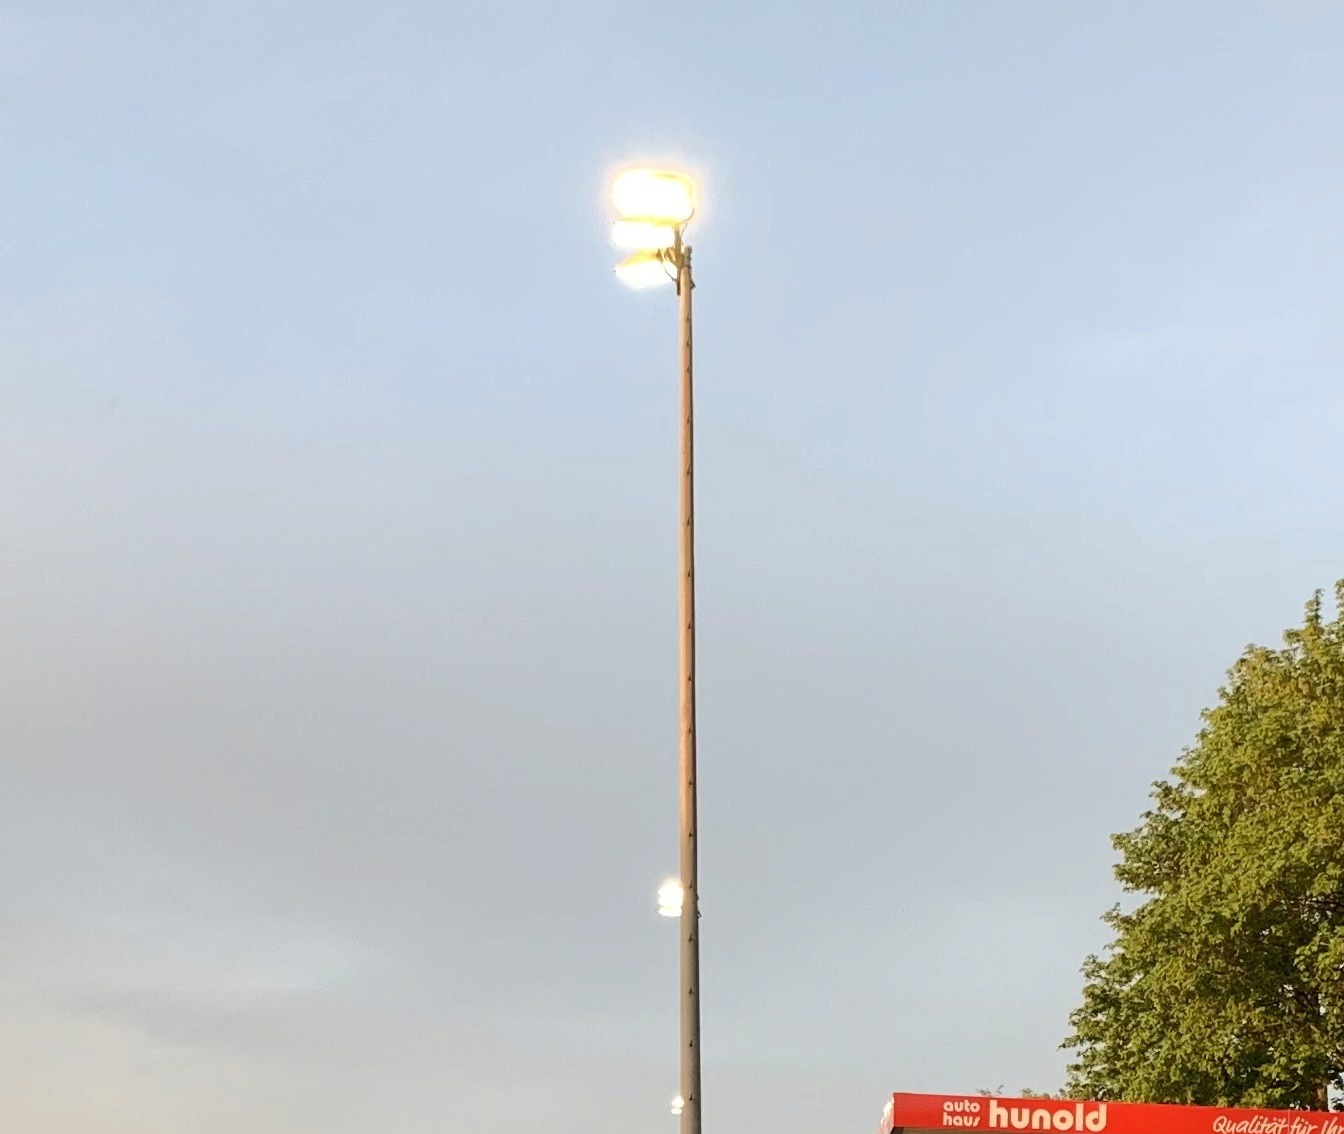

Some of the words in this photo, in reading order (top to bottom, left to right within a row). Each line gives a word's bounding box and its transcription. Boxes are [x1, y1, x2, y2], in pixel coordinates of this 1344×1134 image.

[943, 1099, 981, 1113] auto
[943, 1113, 981, 1127] haus
[989, 1100, 1107, 1132] hunold
